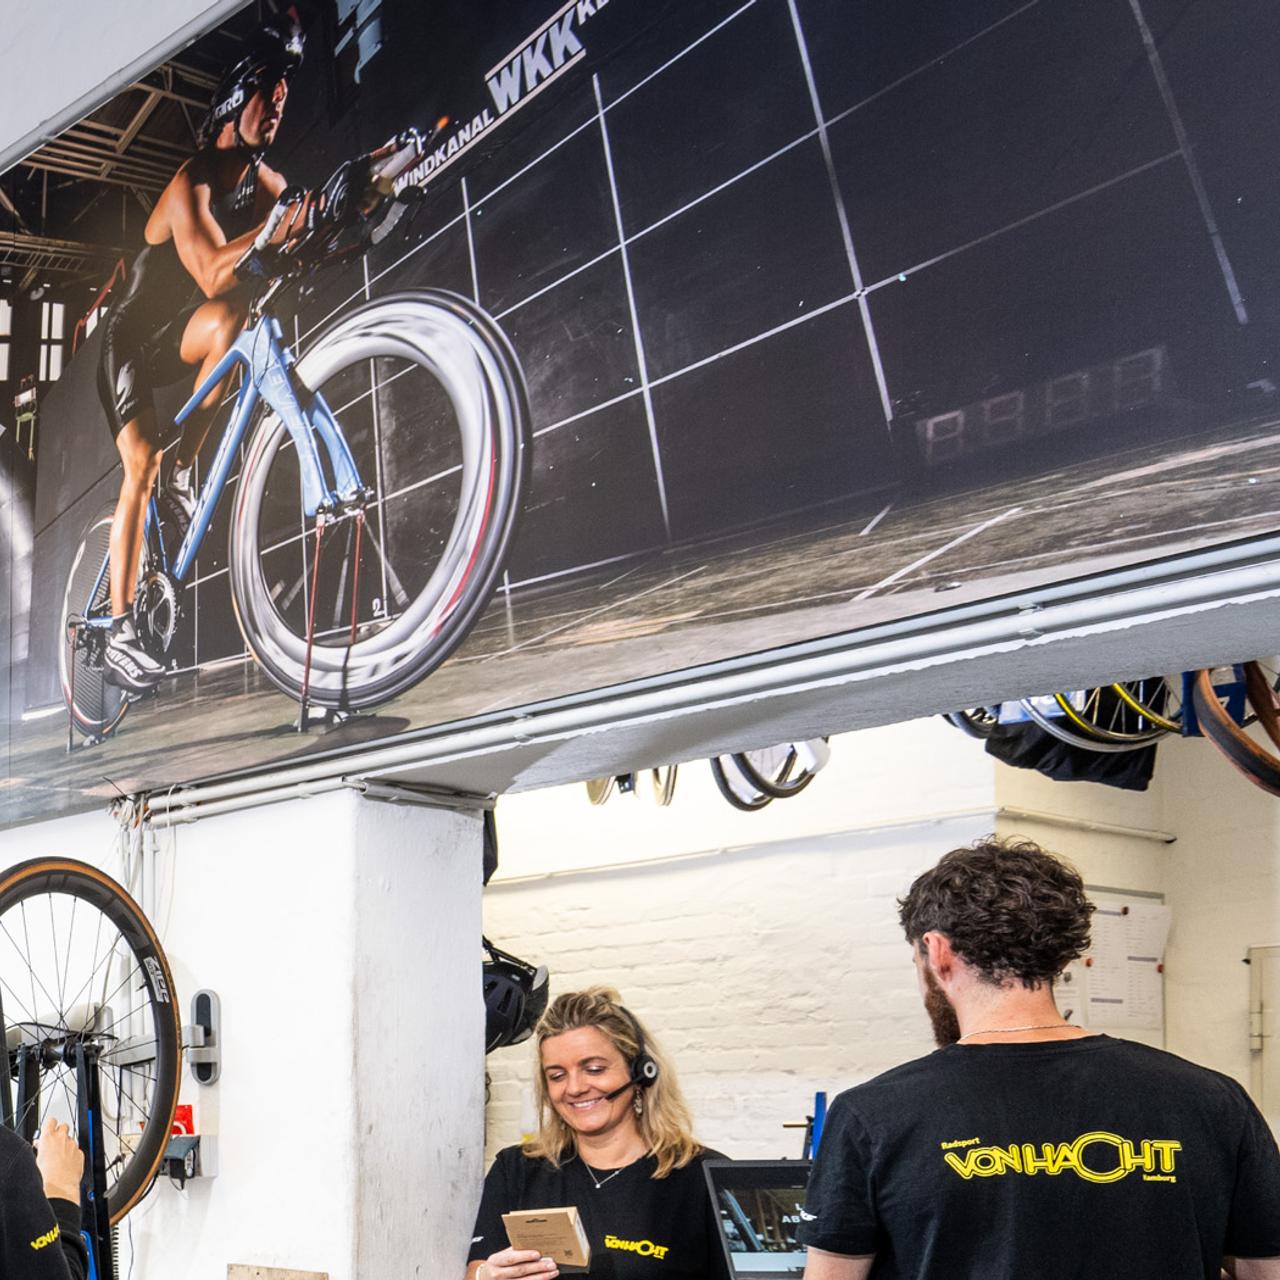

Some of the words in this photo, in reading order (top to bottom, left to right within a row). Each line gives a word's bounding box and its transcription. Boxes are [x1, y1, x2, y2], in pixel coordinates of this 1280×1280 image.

[393, 108, 494, 198] WINDKANAL
[487, 7, 583, 115] WKK
[941, 1137, 981, 1150] Radsport
